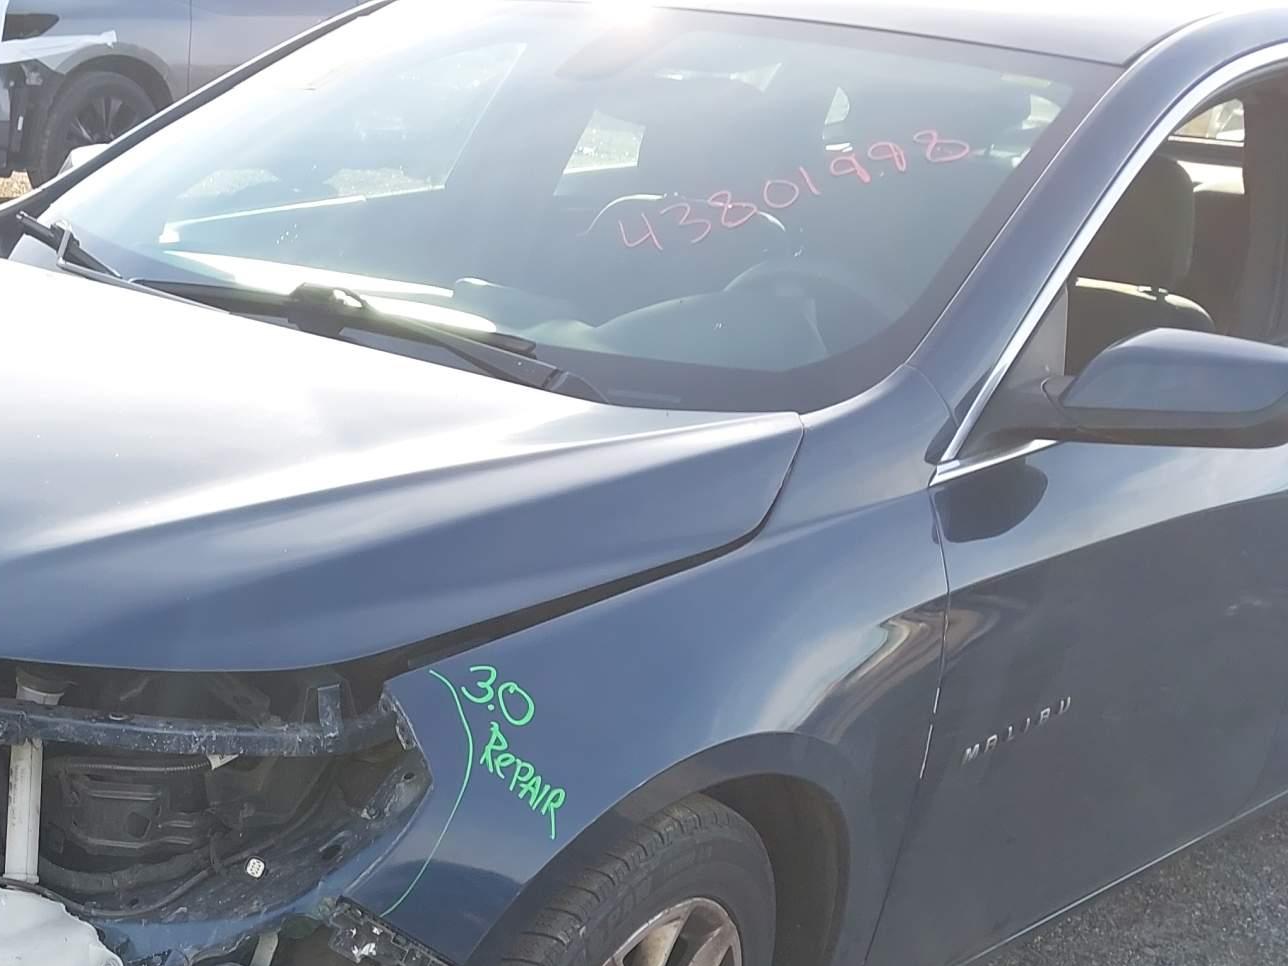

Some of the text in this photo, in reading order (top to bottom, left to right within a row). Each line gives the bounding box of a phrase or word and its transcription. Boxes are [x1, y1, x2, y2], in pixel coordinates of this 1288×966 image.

[616, 129, 970, 250] 43801998
[462, 665, 536, 726] 3.0
[961, 696, 1072, 767] MALIBU
